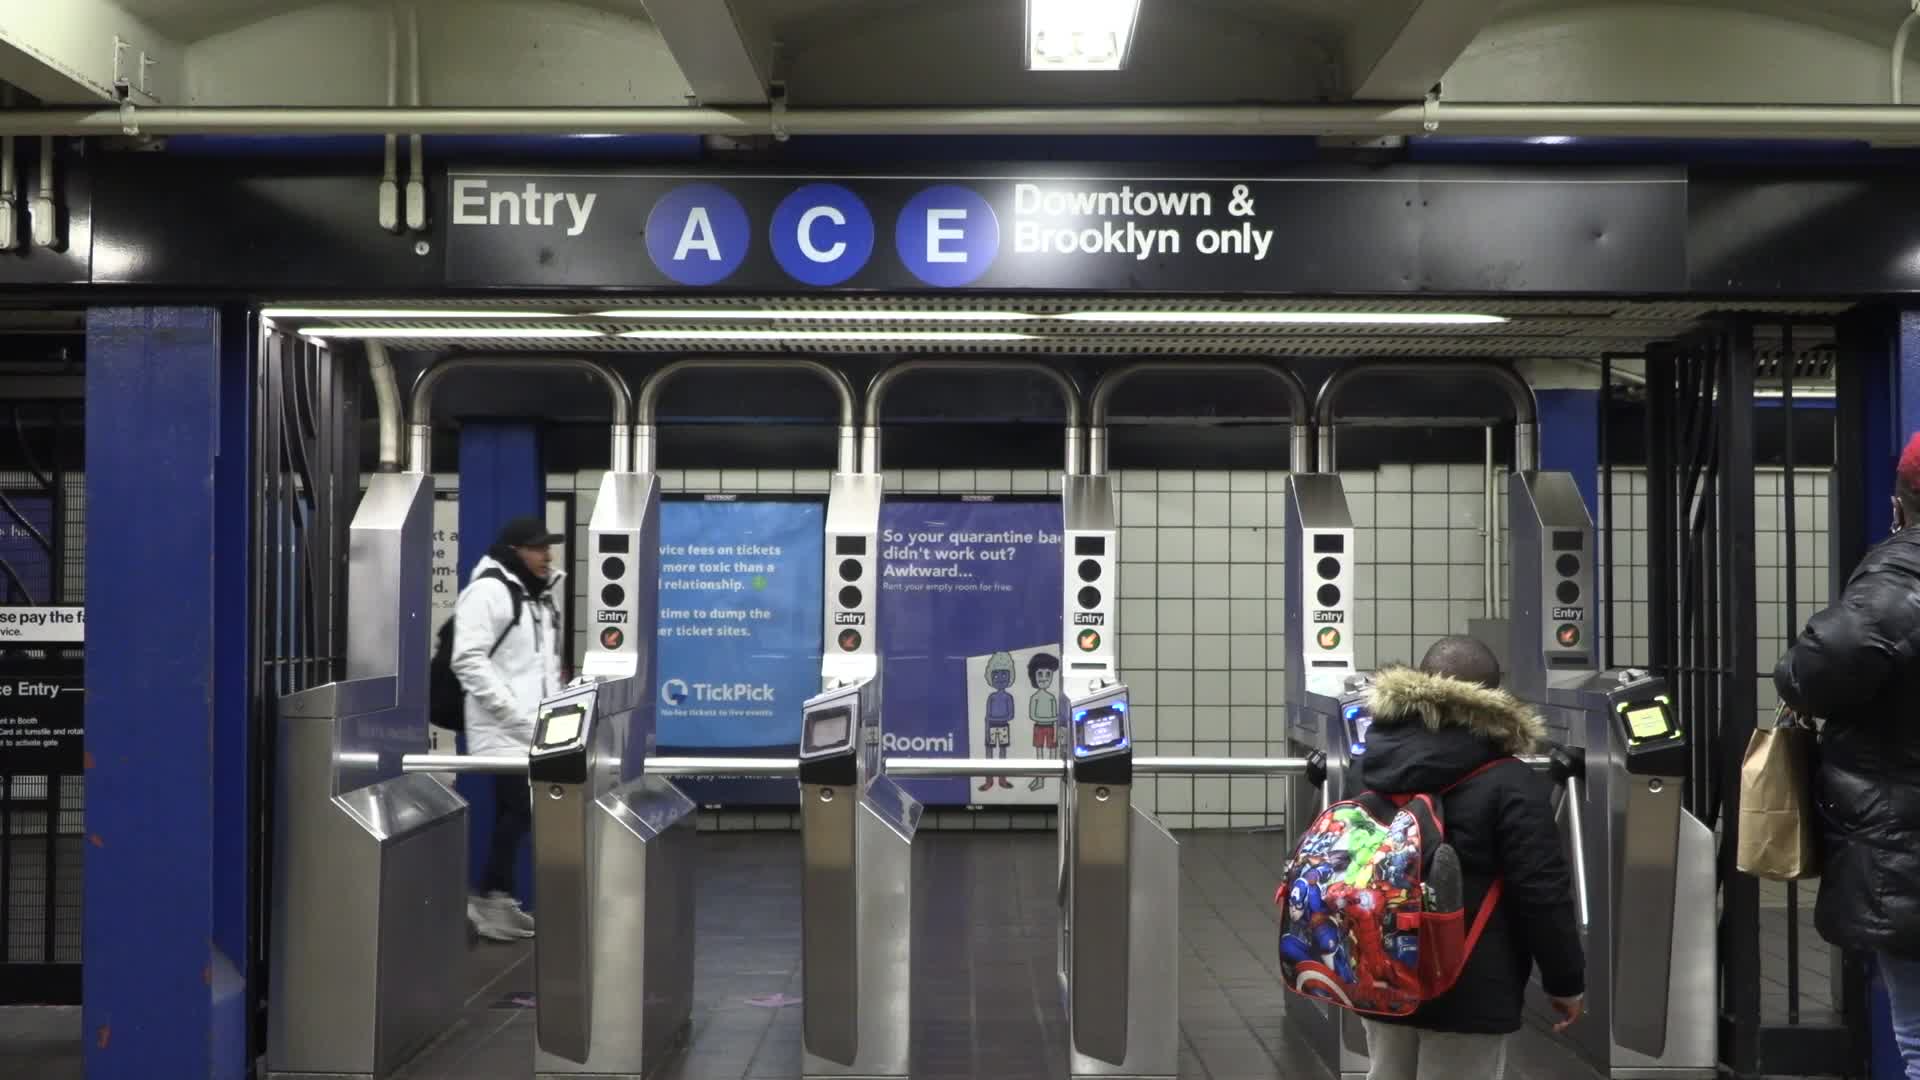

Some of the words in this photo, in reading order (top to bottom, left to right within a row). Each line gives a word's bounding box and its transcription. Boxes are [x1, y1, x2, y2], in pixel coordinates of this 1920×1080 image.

[1014, 184, 1211, 216] Downtown
[1228, 184, 1255, 216] &
[453, 179, 597, 236] Entry
[673, 207, 722, 261] A
[797, 206, 847, 263] C
[926, 208, 968, 263] E
[1014, 221, 1180, 260] Brooklyn
[1196, 222, 1273, 260] only
[883, 529, 903, 543] So
[908, 532, 944, 546] your
[949, 530, 1033, 546] quarantine
[687, 544, 714, 556] fees
[717, 547, 733, 556] on
[736, 545, 781, 556] tickets
[883, 545, 931, 560] didn't
[935, 547, 974, 560] work
[980, 547, 1016, 560] out?
[663, 563, 696, 573] more
[699, 561, 731, 573] toxic
[734, 561, 763, 573] than
[767, 563, 775, 573] a
[883, 563, 973, 578] Awkward...
[665, 578, 745, 592] relationship.
[883, 582, 902, 591] Rent
[904, 583, 923, 592] your
[926, 582, 952, 592] empty
[955, 583, 978, 591] room
[979, 582, 992, 591] for
[19, 613, 47, 626] pay
[50, 610, 74, 623] the
[598, 611, 627, 623] Entry
[661, 608, 690, 619] time
[693, 609, 706, 619] to
[710, 608, 746, 621] dump
[749, 608, 771, 619] the
[835, 612, 864, 624] Entry
[1074, 612, 1103, 625] Entry
[1314, 611, 1343, 623] Entry
[1553, 608, 1582, 620] Entry
[676, 625, 713, 636] ticket
[717, 625, 751, 637] sites.
[18, 681, 59, 698] Entry
[692, 683, 775, 701] TickPick
[882, 732, 953, 752] Roomi
